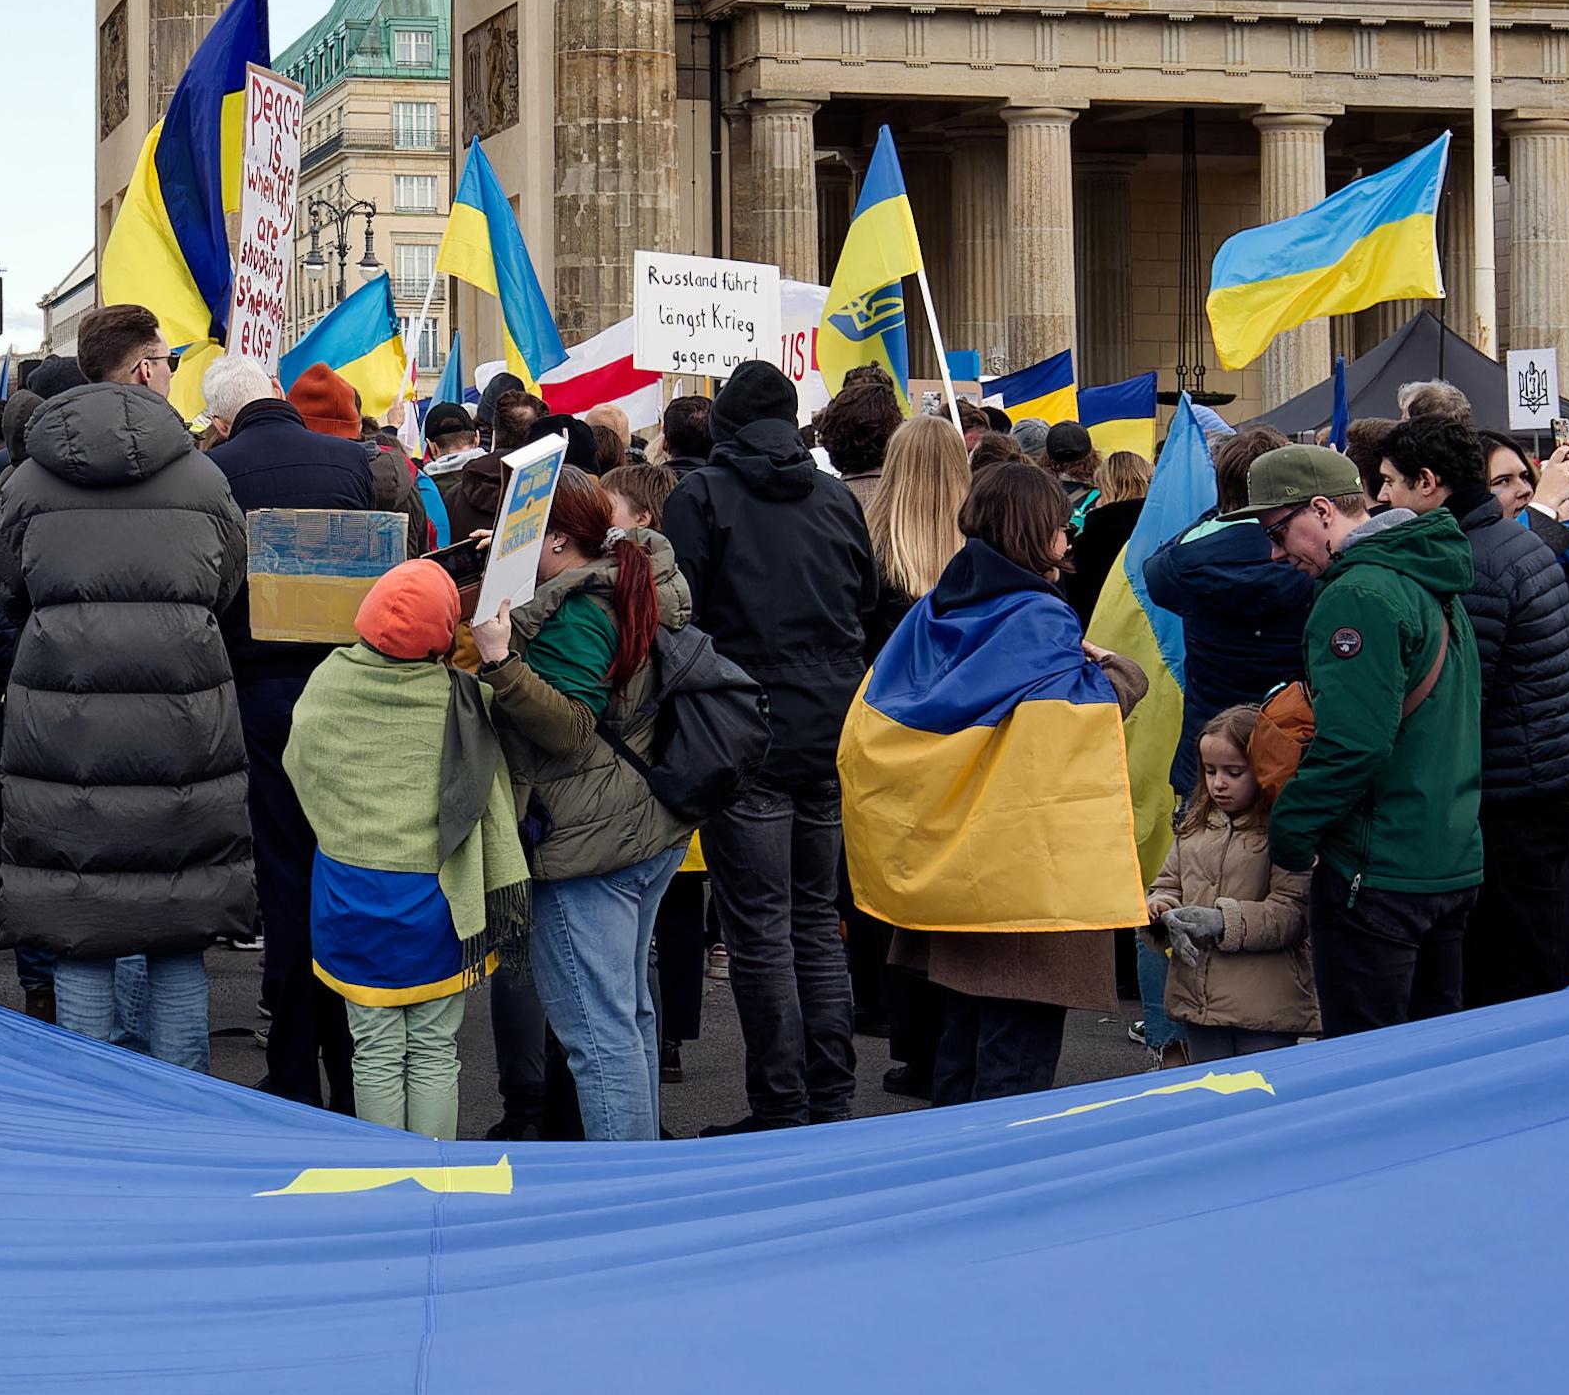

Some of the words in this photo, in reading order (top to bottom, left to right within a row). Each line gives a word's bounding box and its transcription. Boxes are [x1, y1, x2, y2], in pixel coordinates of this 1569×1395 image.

[252, 75, 300, 147] peace
[268, 126, 282, 175] is
[257, 216, 278, 251] are
[648, 265, 717, 289] Russland
[722, 271, 759, 294] führt
[241, 319, 272, 365] else
[659, 304, 706, 337] längst
[711, 303, 755, 342] Krieg
